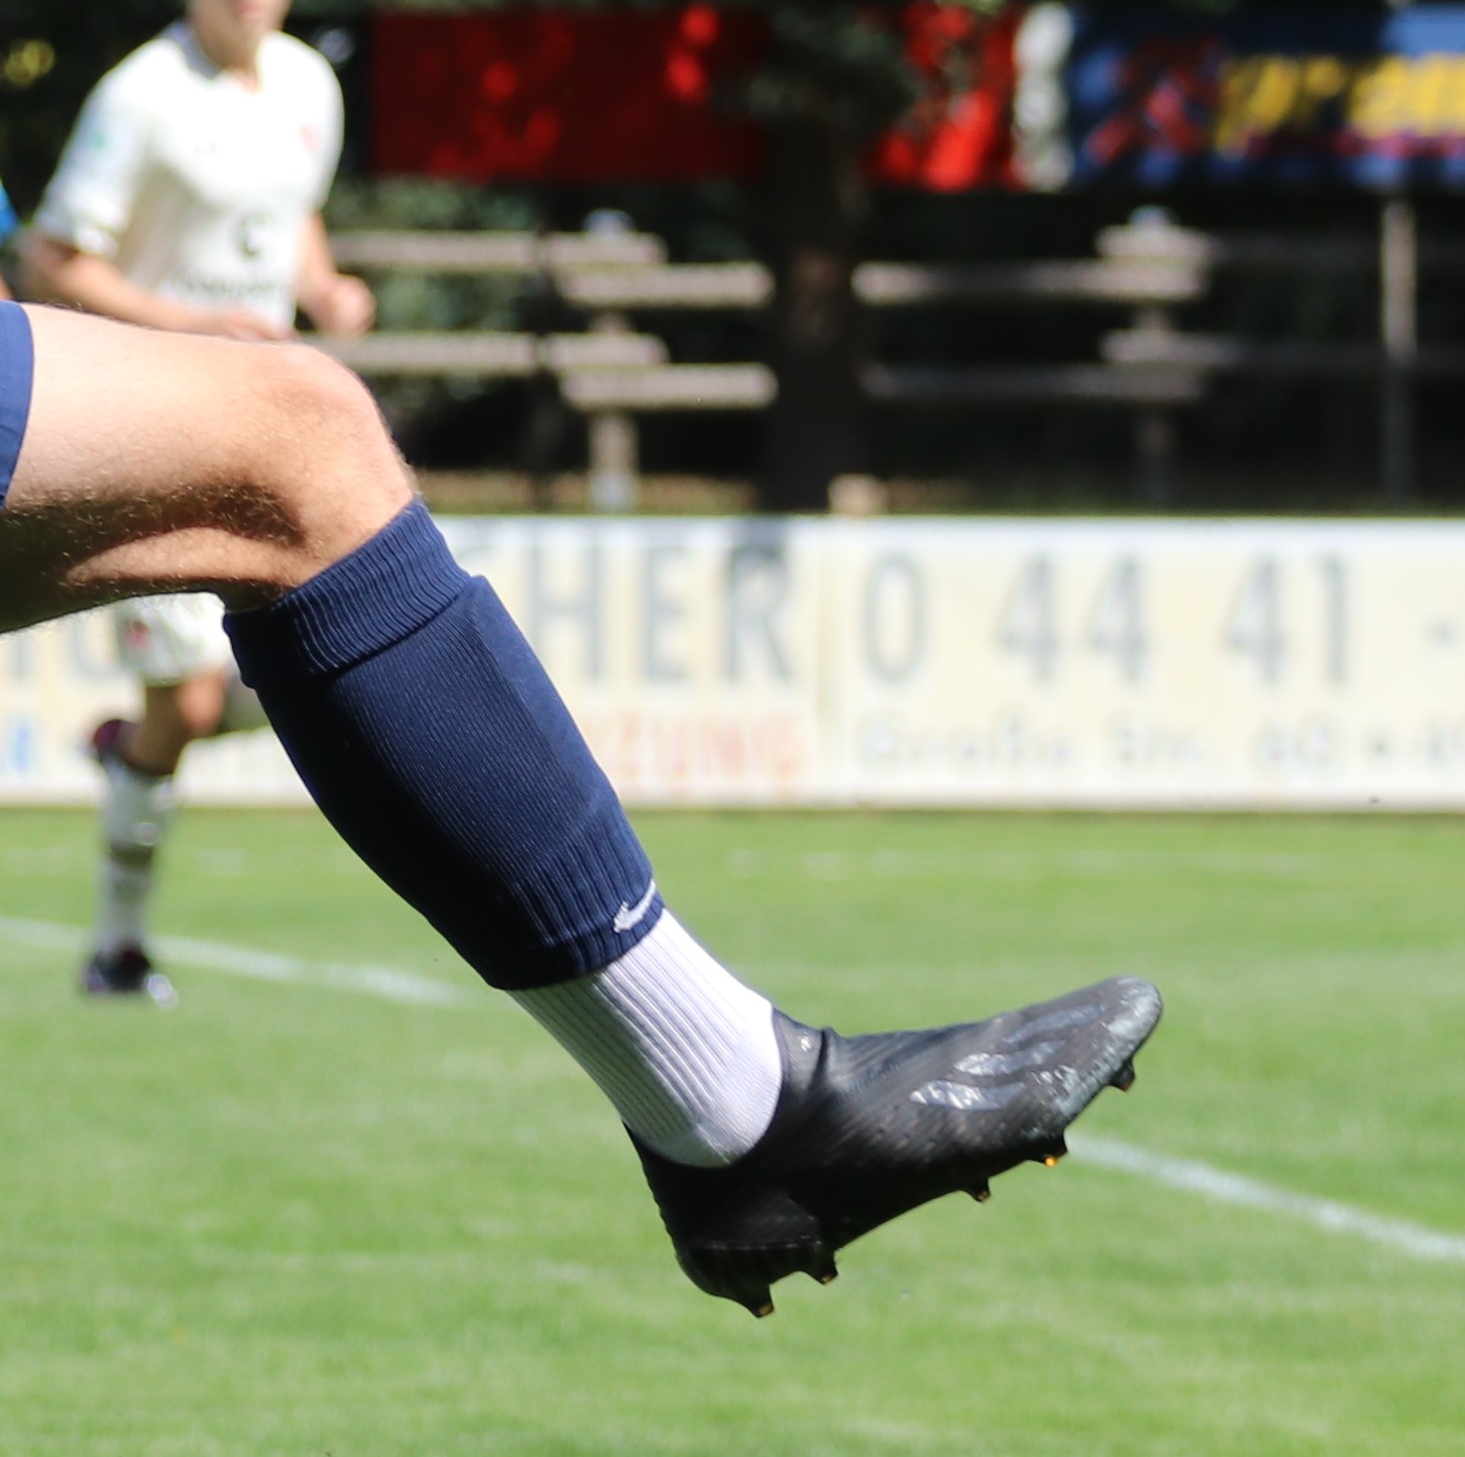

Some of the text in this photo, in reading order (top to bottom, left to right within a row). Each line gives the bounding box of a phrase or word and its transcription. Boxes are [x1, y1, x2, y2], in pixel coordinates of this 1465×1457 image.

[461, 534, 797, 686] HER
[857, 548, 929, 685] 0
[995, 548, 1147, 685] 44
[1223, 548, 1355, 685] 41
